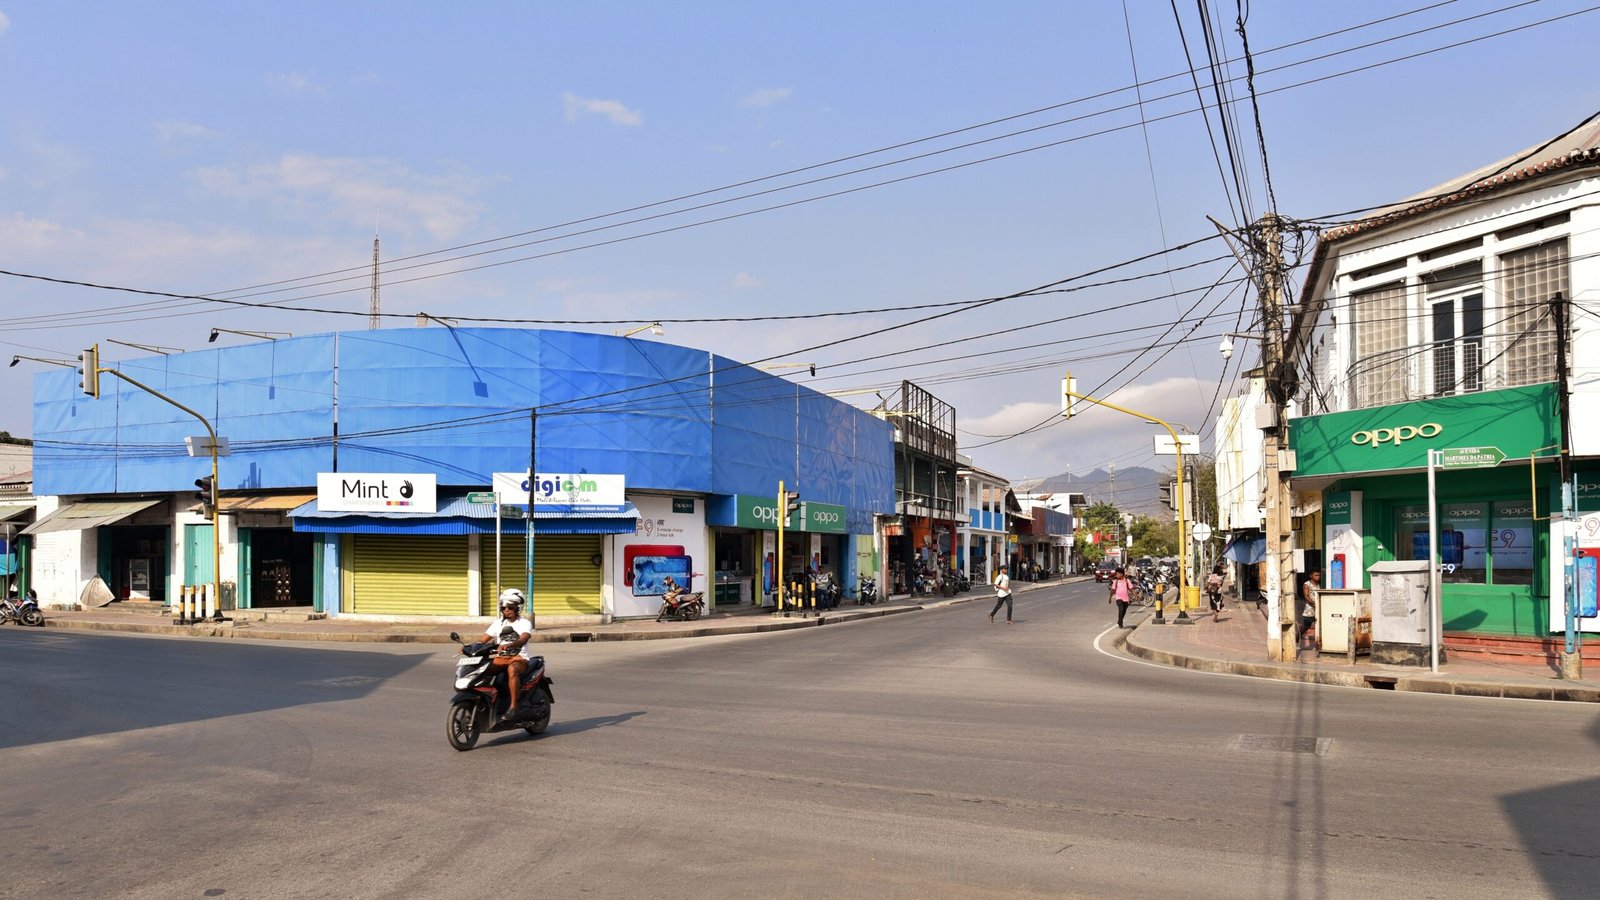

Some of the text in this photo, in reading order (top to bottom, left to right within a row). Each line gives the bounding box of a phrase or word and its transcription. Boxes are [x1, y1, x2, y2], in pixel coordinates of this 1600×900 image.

[1351, 423, 1443, 448] oppo
[342, 479, 389, 498] Mint
[1329, 501, 1348, 510] oppo
[813, 511, 839, 525] oppo
[1448, 509, 1481, 517] oppo
[1440, 563, 1456, 575] F9
